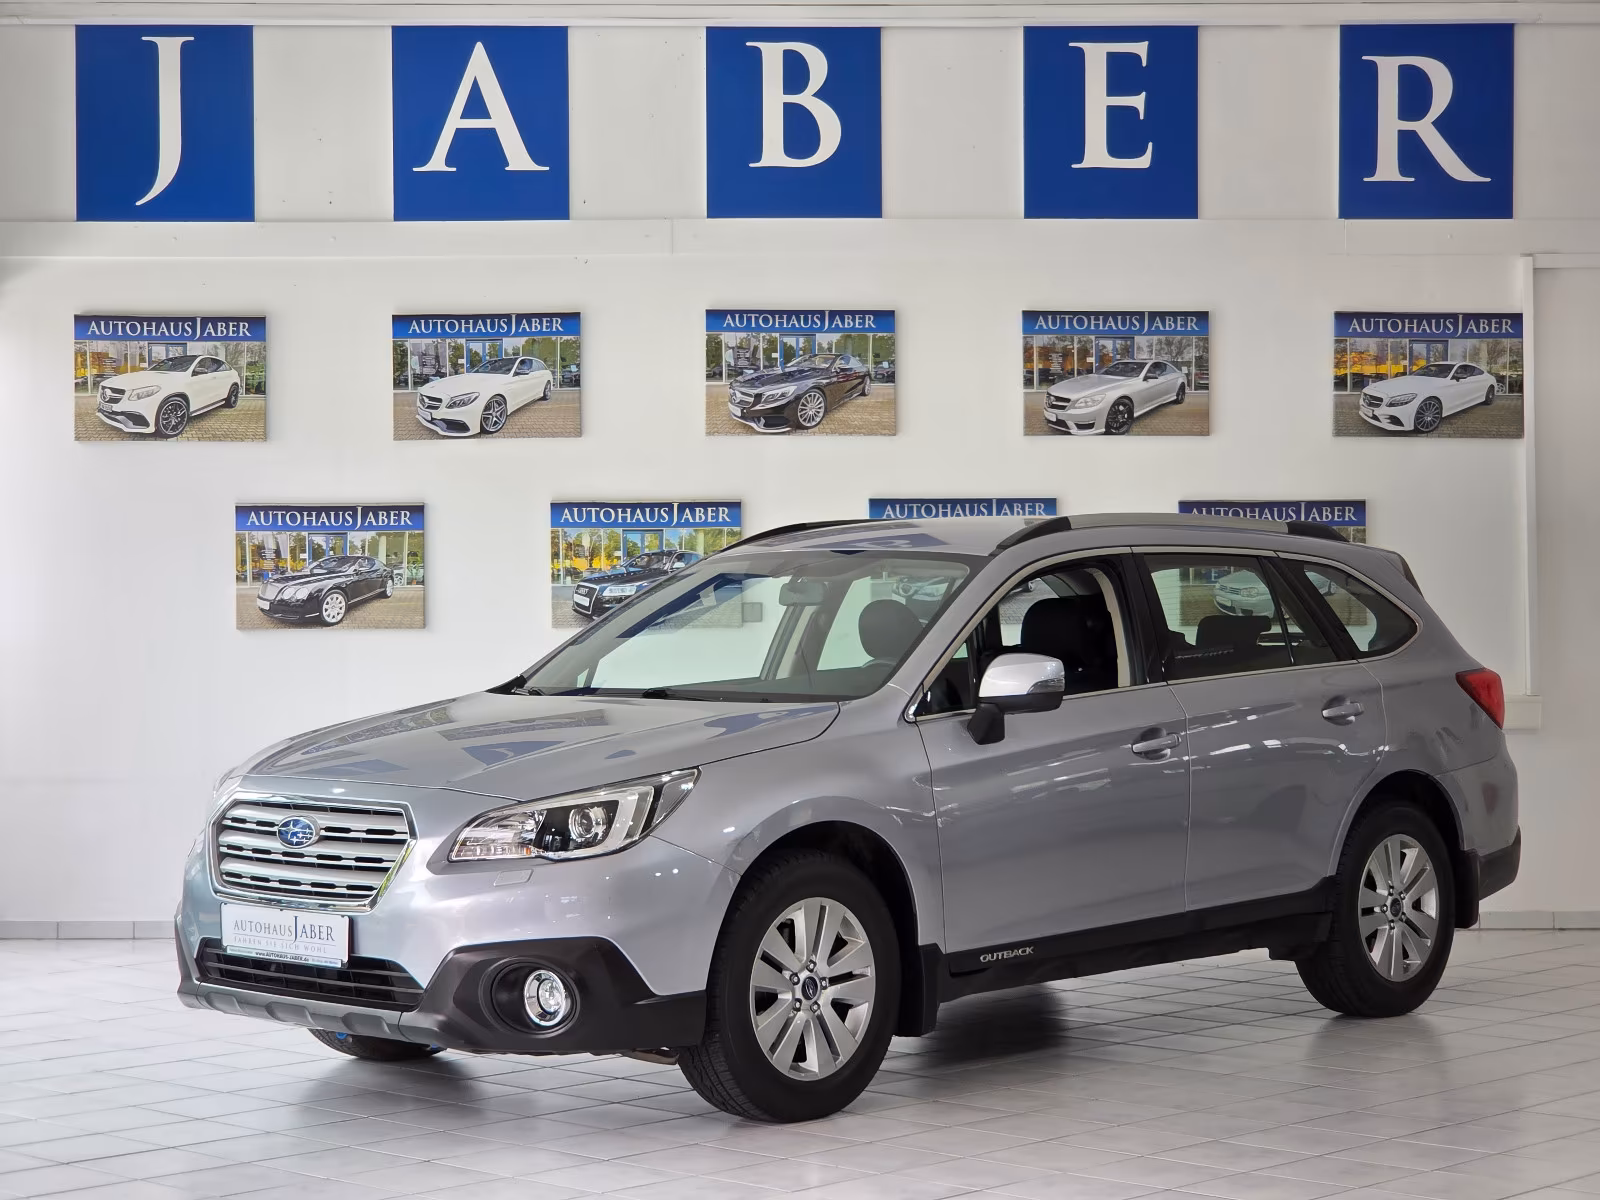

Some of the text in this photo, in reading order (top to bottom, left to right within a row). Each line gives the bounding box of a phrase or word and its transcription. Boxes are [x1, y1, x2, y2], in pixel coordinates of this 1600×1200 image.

[136, 36, 1492, 206] J A B E R
[234, 936, 262, 946] FAHREN
[281, 942, 300, 950] SICH
[304, 945, 327, 953] WOHL
[979, 946, 1035, 963] OUTBACK
